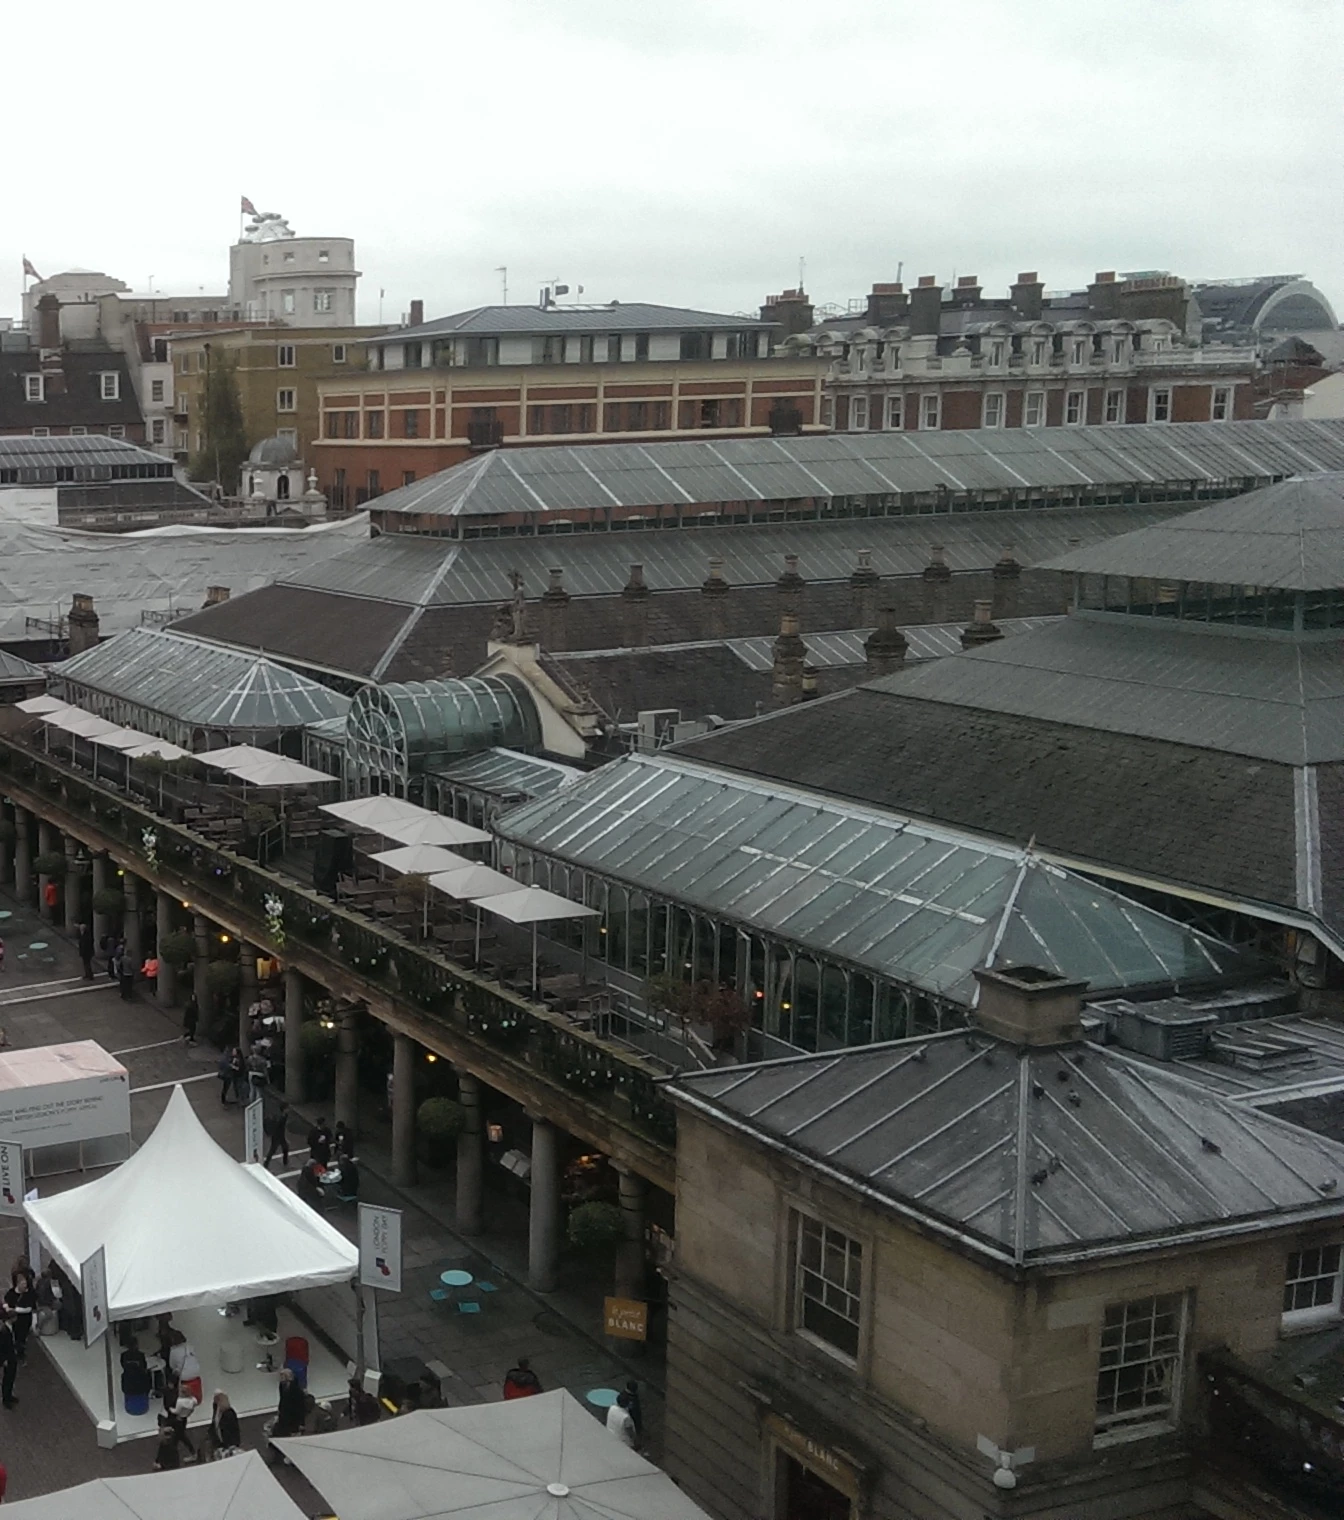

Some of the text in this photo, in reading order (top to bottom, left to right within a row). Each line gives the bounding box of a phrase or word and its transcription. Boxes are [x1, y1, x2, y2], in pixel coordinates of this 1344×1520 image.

[0, 1145, 11, 1186] LIVE ON
[373, 1215, 381, 1250] LONDON
[608, 1318, 644, 1332] BLANC
